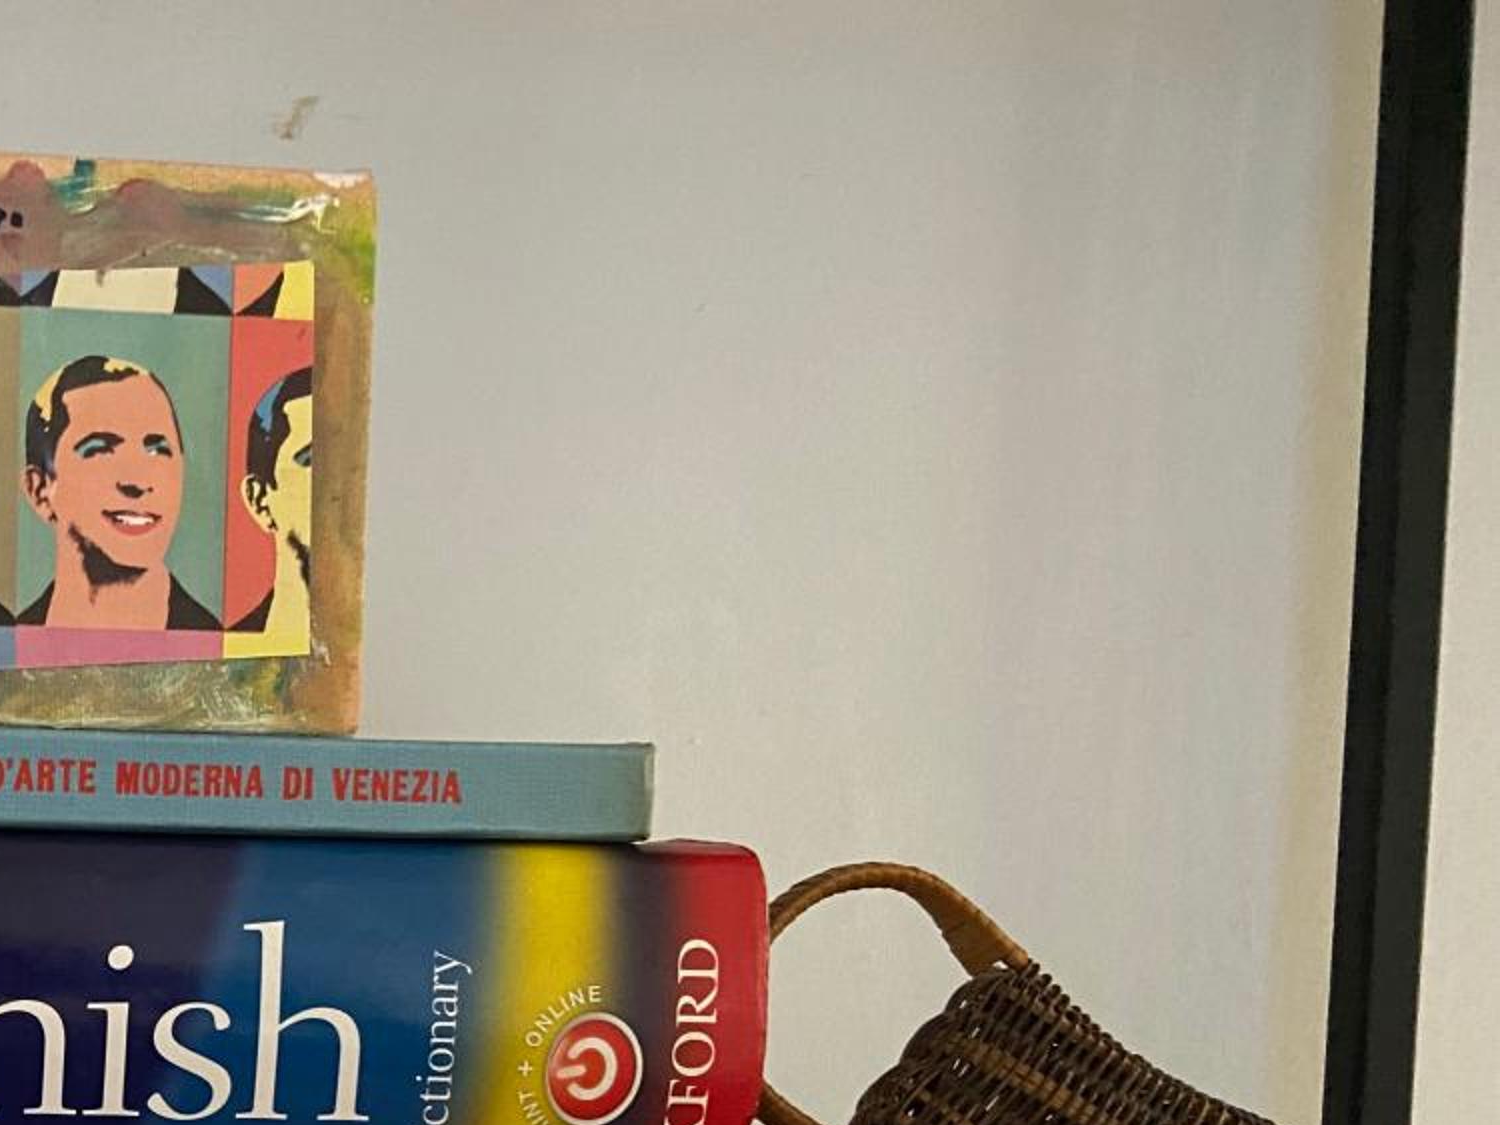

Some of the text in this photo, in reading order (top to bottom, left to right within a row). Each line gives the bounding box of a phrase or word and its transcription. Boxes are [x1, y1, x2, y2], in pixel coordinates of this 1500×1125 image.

[115, 760, 264, 798] MODERNA
[282, 766, 314, 801] DI
[332, 767, 462, 804] VENEZIA
[525, 985, 602, 1047] ONLINE
